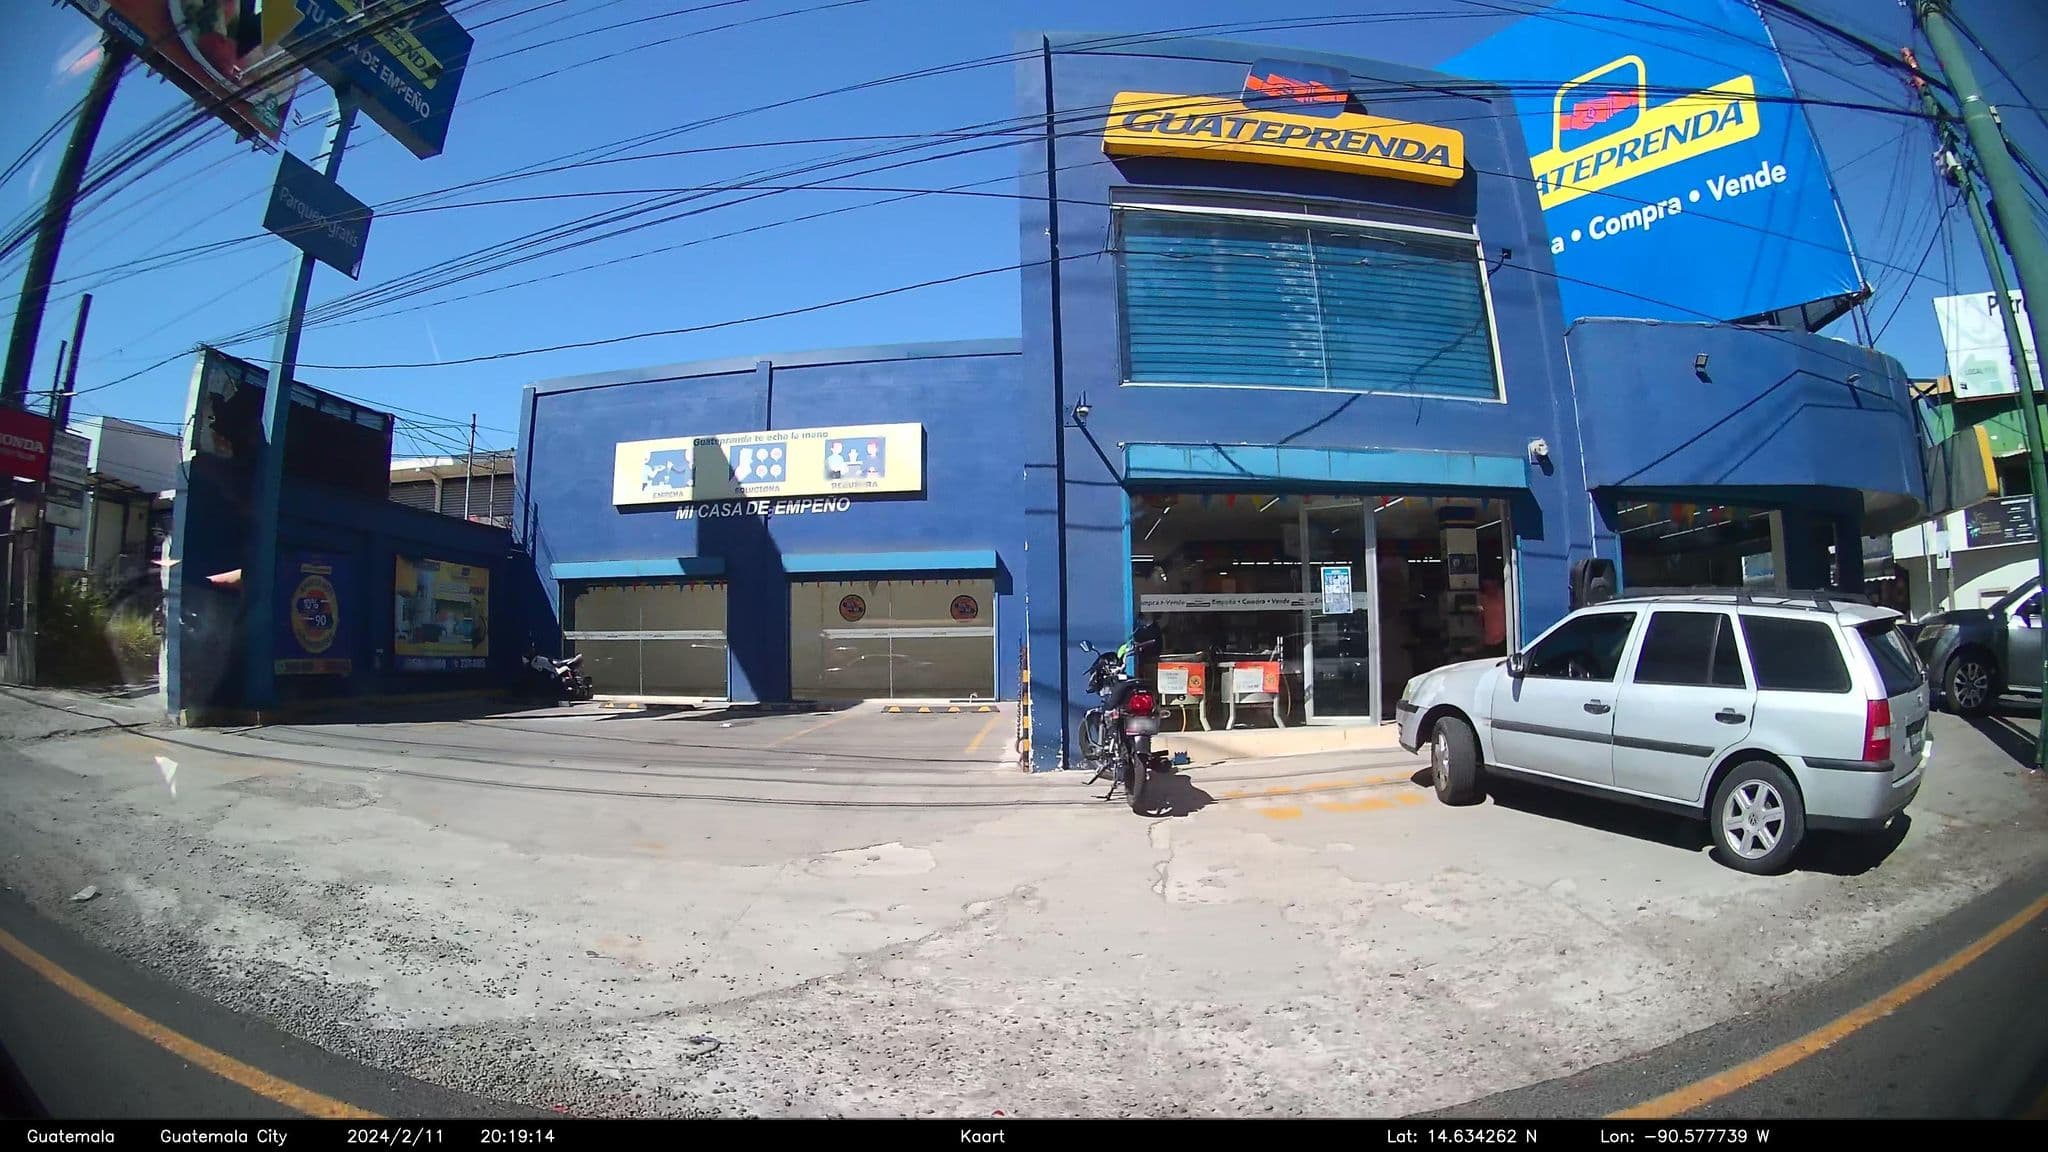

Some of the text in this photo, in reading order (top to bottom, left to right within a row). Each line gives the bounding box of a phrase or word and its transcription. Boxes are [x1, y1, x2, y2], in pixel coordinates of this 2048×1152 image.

[360, 52, 380, 74] DE
[380, 65, 430, 119] EMPEÑO
[1121, 110, 1450, 167] GUATEPRENDA
[1588, 195, 1682, 241] Compra
[1706, 161, 1787, 202] Vende
[327, 220, 359, 248] gratis
[675, 495, 851, 520] MI CASA DE EMPEÑO
